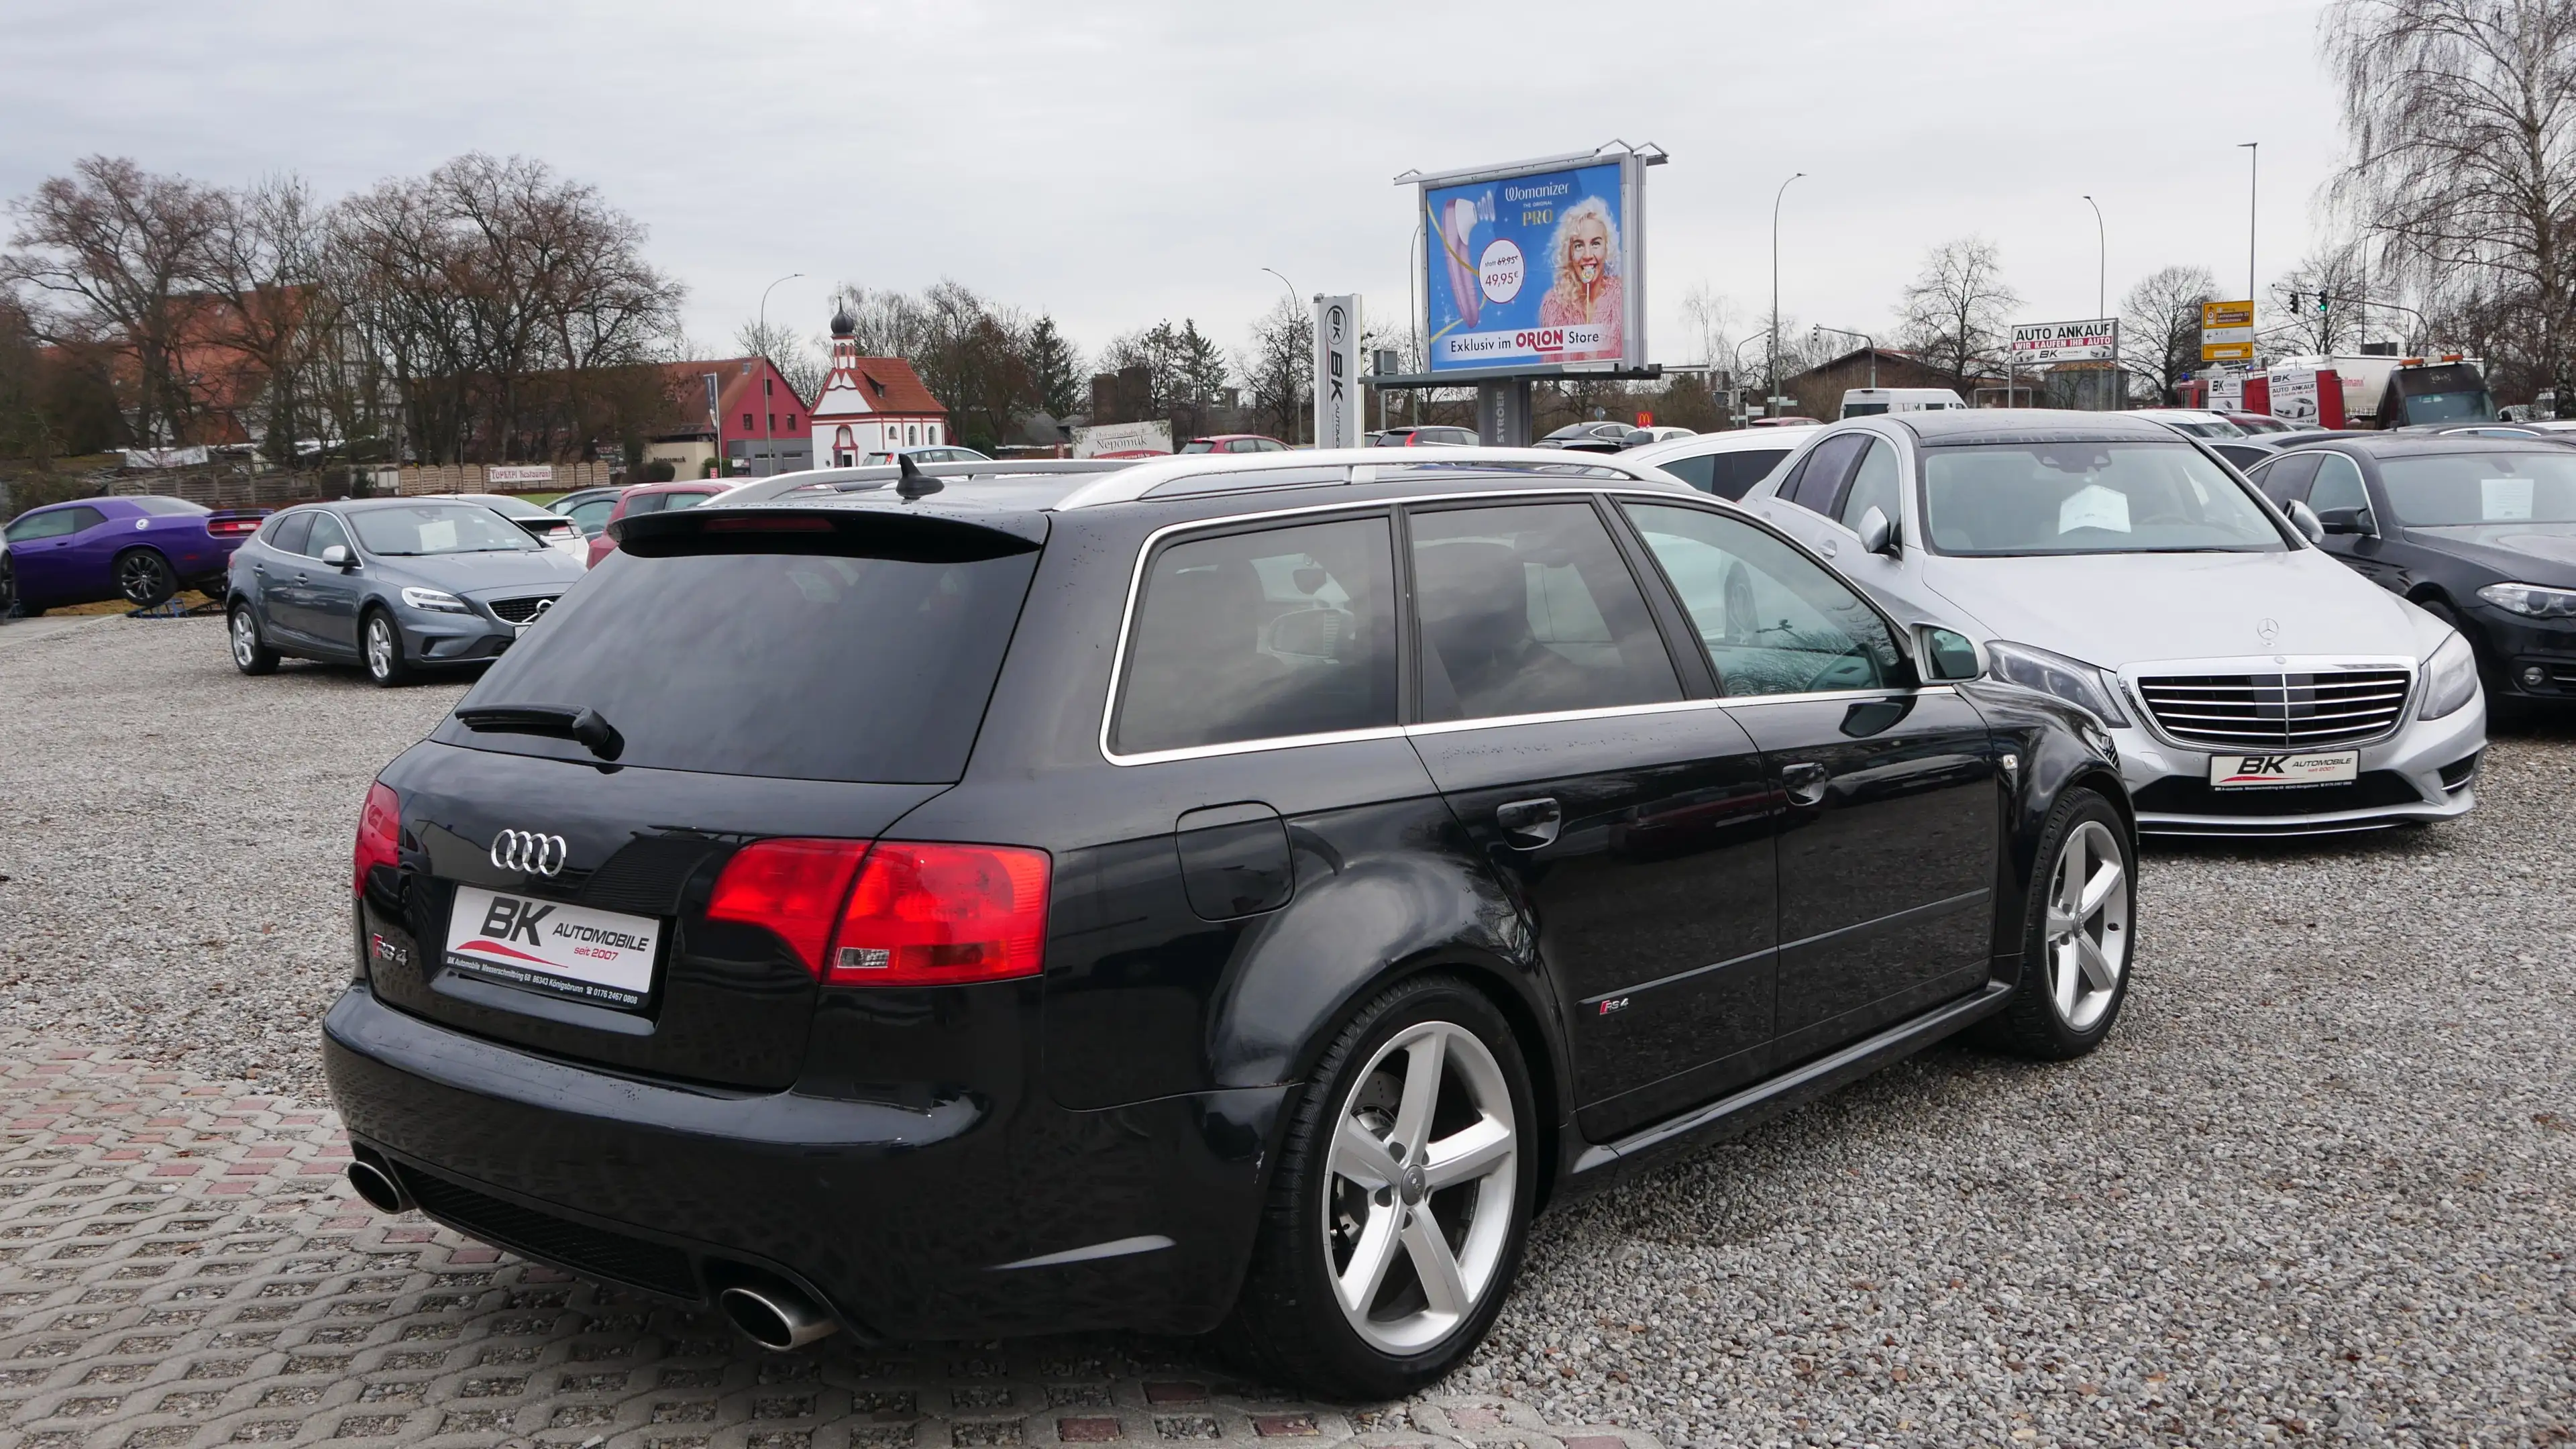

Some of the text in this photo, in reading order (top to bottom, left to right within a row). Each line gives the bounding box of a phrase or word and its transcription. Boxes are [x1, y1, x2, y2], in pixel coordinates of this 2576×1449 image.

[1505, 181, 1570, 201] Womanizer
[1523, 209, 1553, 227] PRO
[1485, 271, 1519, 287] 49,95€
[1333, 310, 1340, 341] BK
[2016, 323, 2110, 341] AUTO ANKAUF
[1451, 329, 1599, 352] Exklusiv im ORION Store
[2015, 337, 2110, 350] WIR KAUFEN IHR AUTO
[2039, 350, 2058, 358] BK
[1331, 350, 1343, 402] BK
[2272, 374, 2291, 382] BK
[2212, 380, 2224, 392] BK
[2292, 383, 2314, 391] ANKAUF
[1097, 435, 1147, 451] Nepomuk
[2236, 755, 2353, 775] BK AUTOMOBILE
[480, 896, 649, 952] BK AUTOMOBILE
[574, 946, 619, 961] seit 2007
[447, 956, 455, 965] BK
[455, 958, 480, 971] Automobile
[549, 978, 584, 993] Königsbrunn
[593, 988, 608, 998] 0176
[608, 991, 623, 1001] 2467
